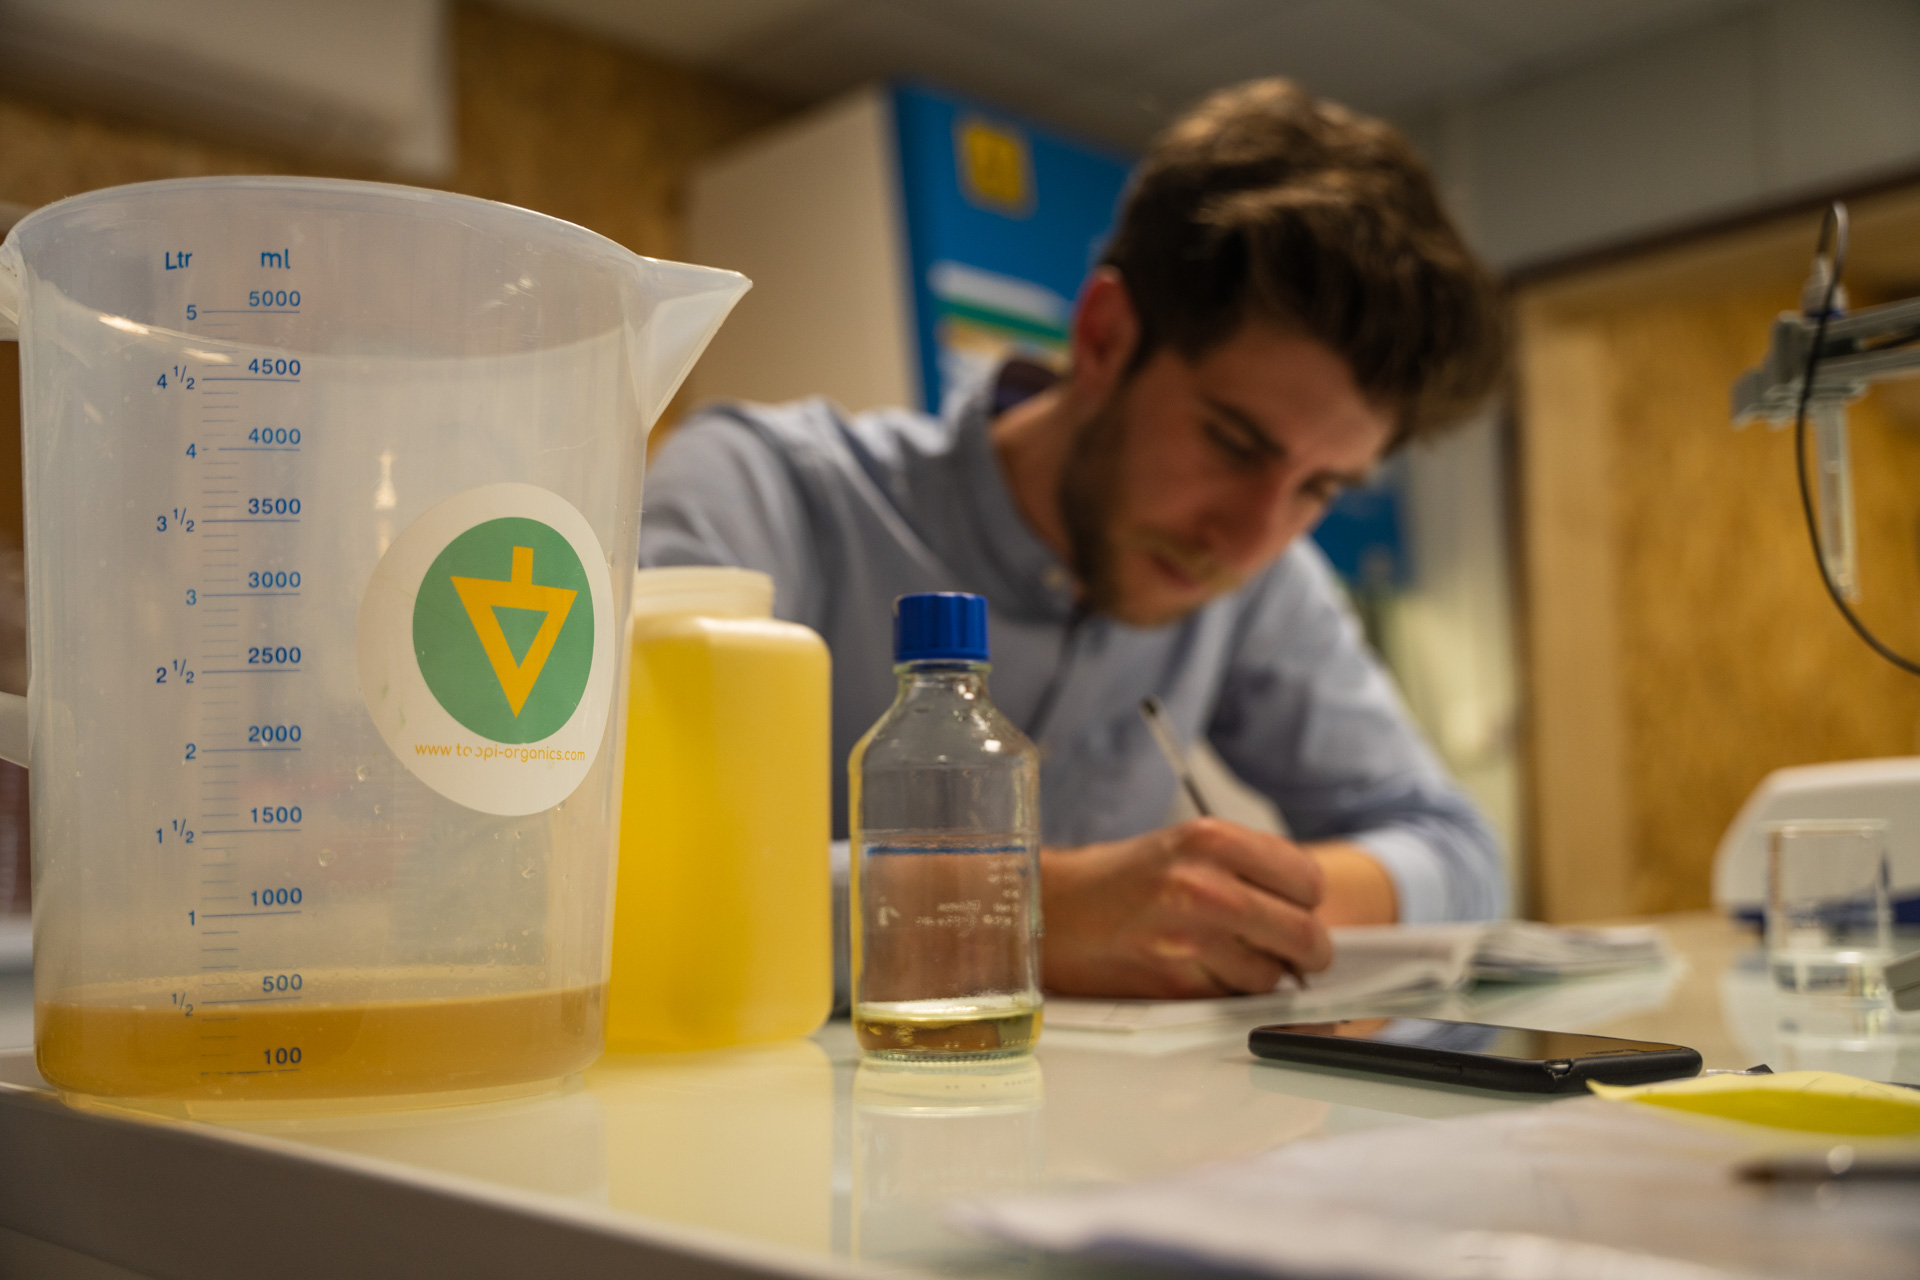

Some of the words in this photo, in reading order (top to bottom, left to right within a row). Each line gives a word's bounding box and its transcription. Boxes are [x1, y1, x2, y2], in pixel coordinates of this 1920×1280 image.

[165, 251, 193, 270] Ltr
[260, 248, 291, 269] ml
[249, 290, 301, 307] 5000
[186, 304, 197, 320] 5
[248, 358, 301, 376] 4500
[248, 427, 301, 445] 4000
[186, 443, 197, 459] 4
[248, 497, 301, 515] 3500
[248, 571, 301, 588] 3000
[186, 589, 197, 606] 3
[248, 647, 302, 664] 2500
[248, 725, 302, 743] 2000
[185, 743, 197, 760] 2
[251, 806, 302, 824] 1500
[251, 887, 302, 906] 1000
[188, 910, 195, 926] 1
[262, 973, 303, 993] 500
[172, 992, 194, 1017] 1/2
[264, 1047, 302, 1065] 100
